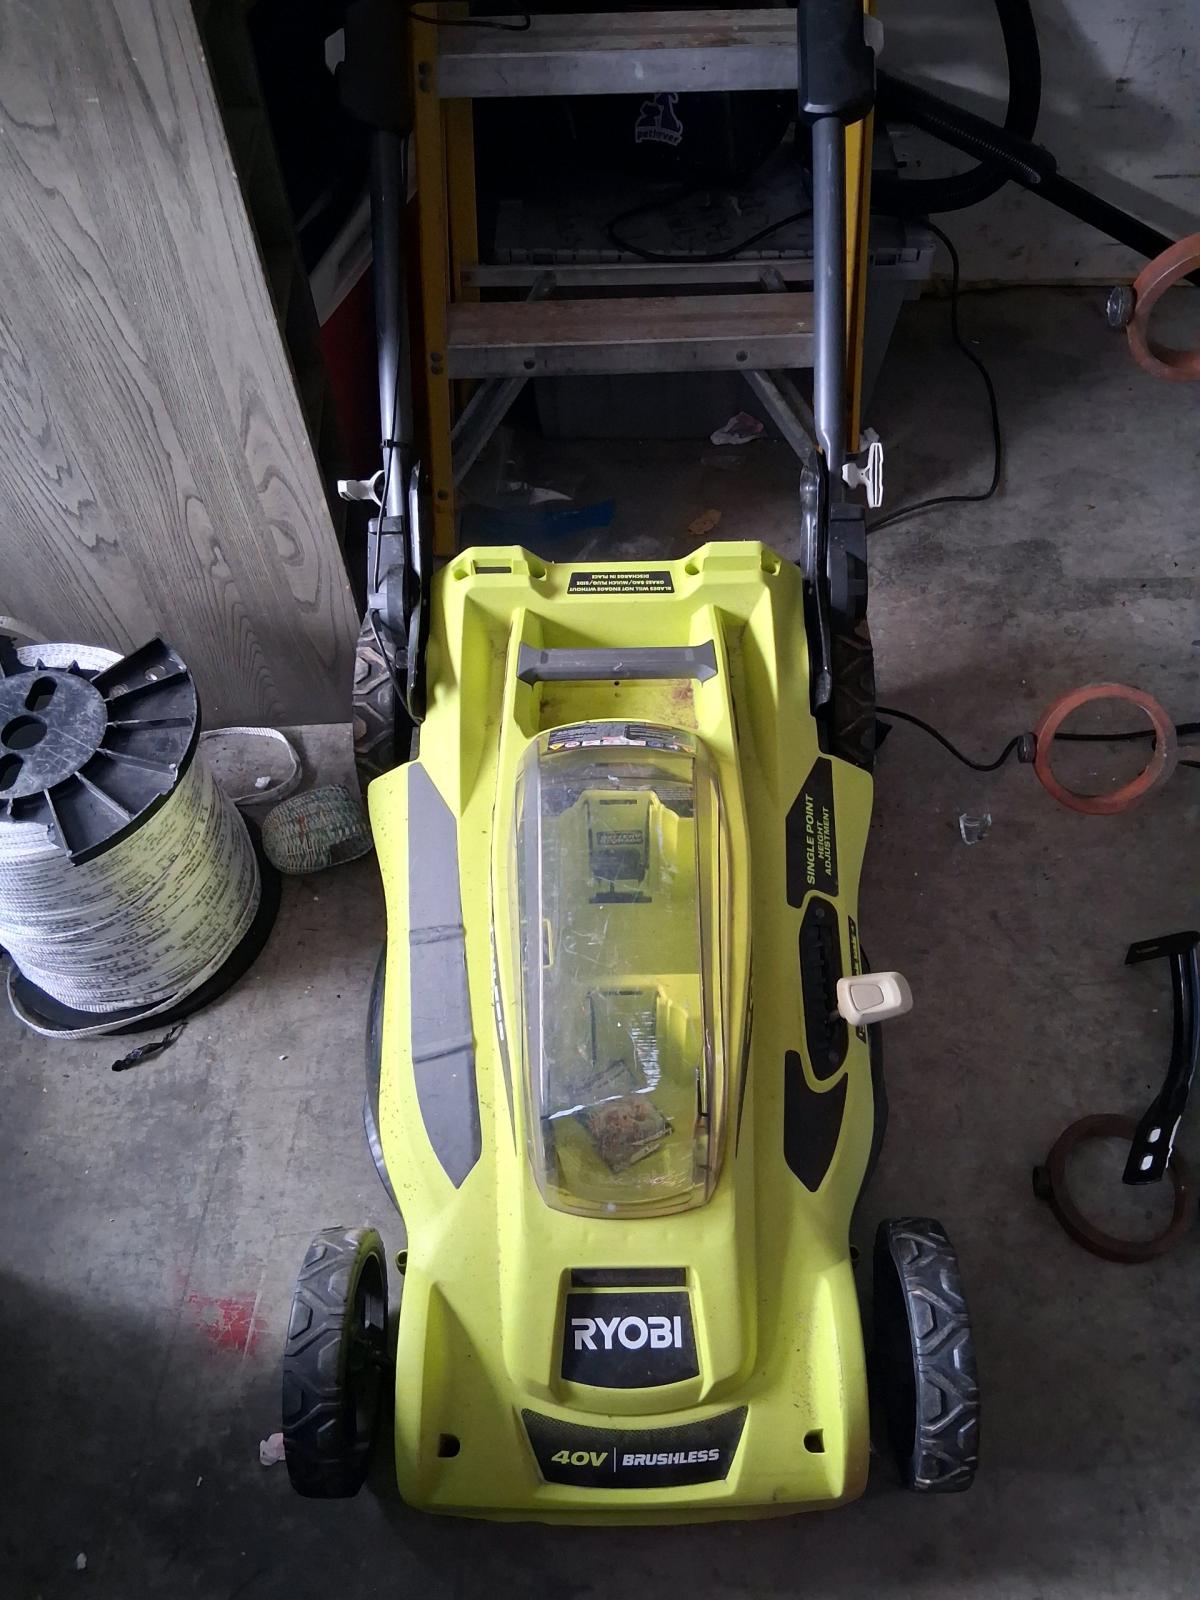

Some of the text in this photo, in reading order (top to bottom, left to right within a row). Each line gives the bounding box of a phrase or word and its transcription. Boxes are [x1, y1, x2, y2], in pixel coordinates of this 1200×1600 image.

[804, 793, 816, 885] SINGLE POINT
[816, 820, 825, 860] HEIGHT
[822, 806, 832, 877] ADJUSTMENT
[571, 1315, 683, 1350] RYOBI
[551, 1448, 721, 1467] 40V BRUSHLESS
